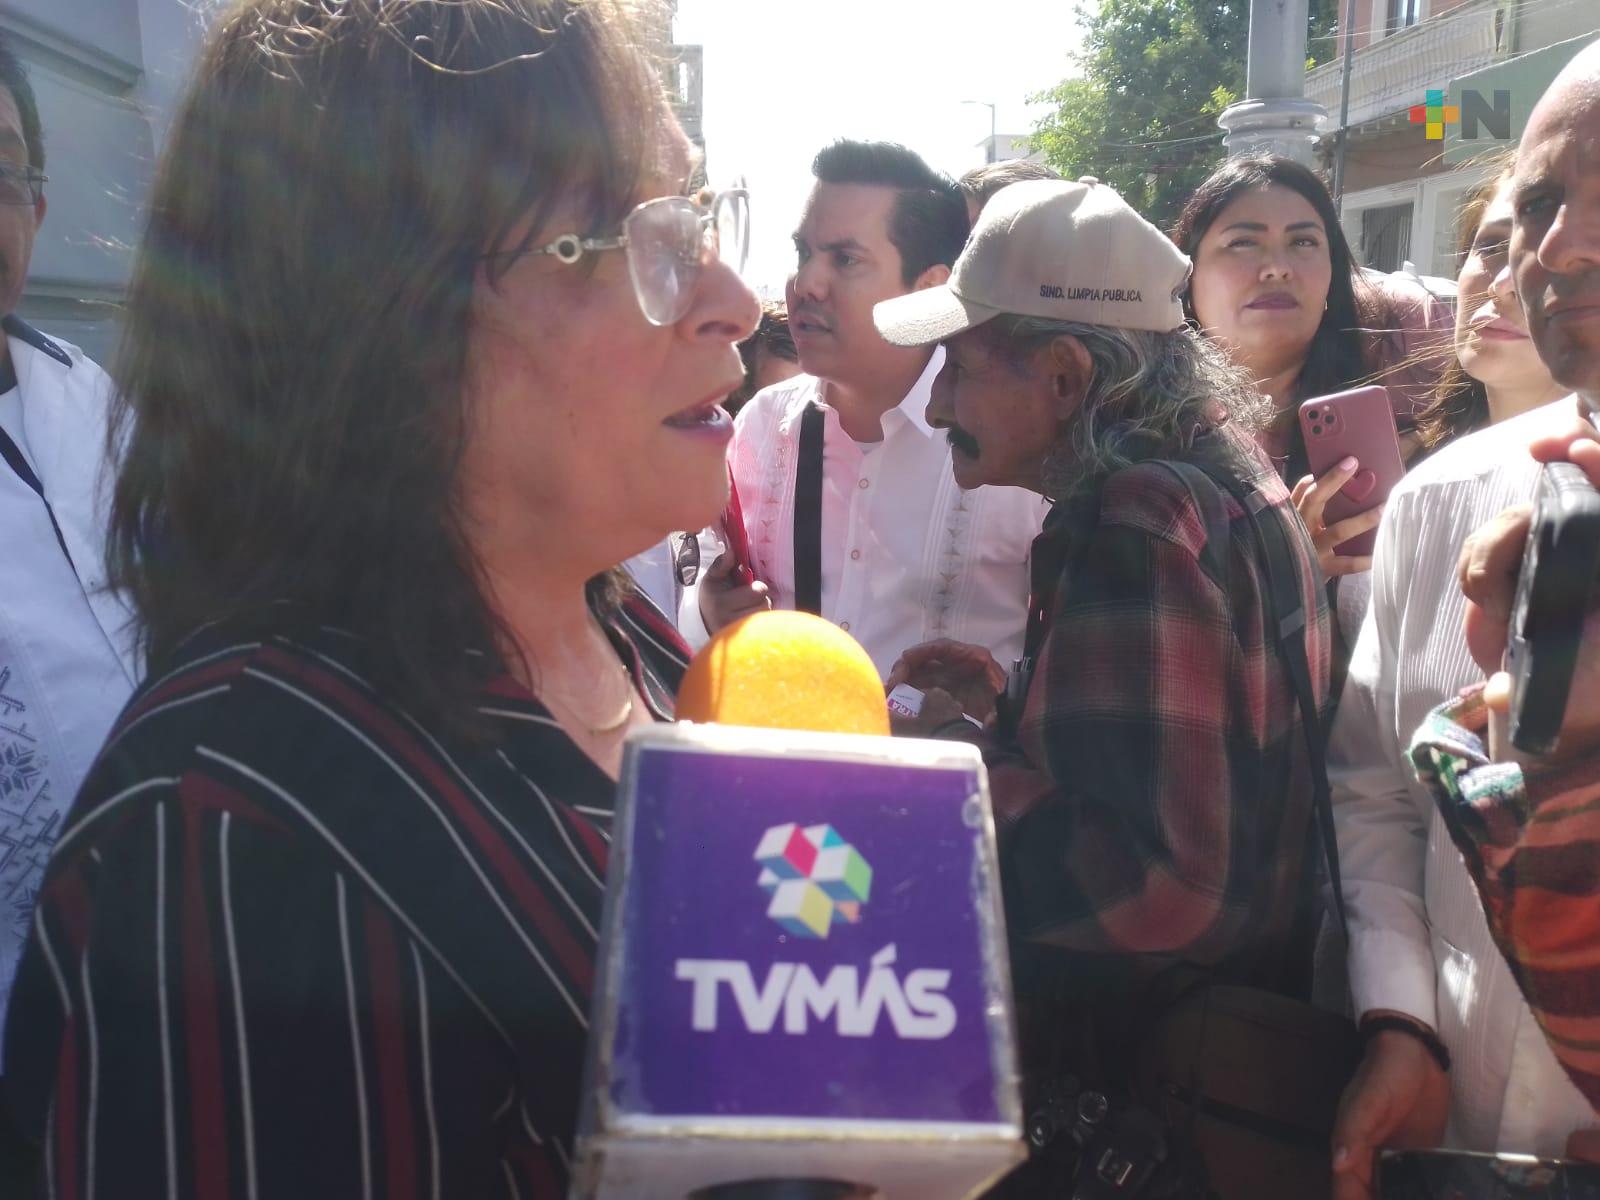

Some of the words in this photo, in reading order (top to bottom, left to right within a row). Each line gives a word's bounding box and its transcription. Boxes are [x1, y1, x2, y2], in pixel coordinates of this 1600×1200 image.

[1040, 285, 1065, 299] SIND.
[1067, 287, 1100, 301] LIMPIA
[1101, 288, 1142, 302] PUBLICA
[675, 943, 957, 1039] TVMÁS
